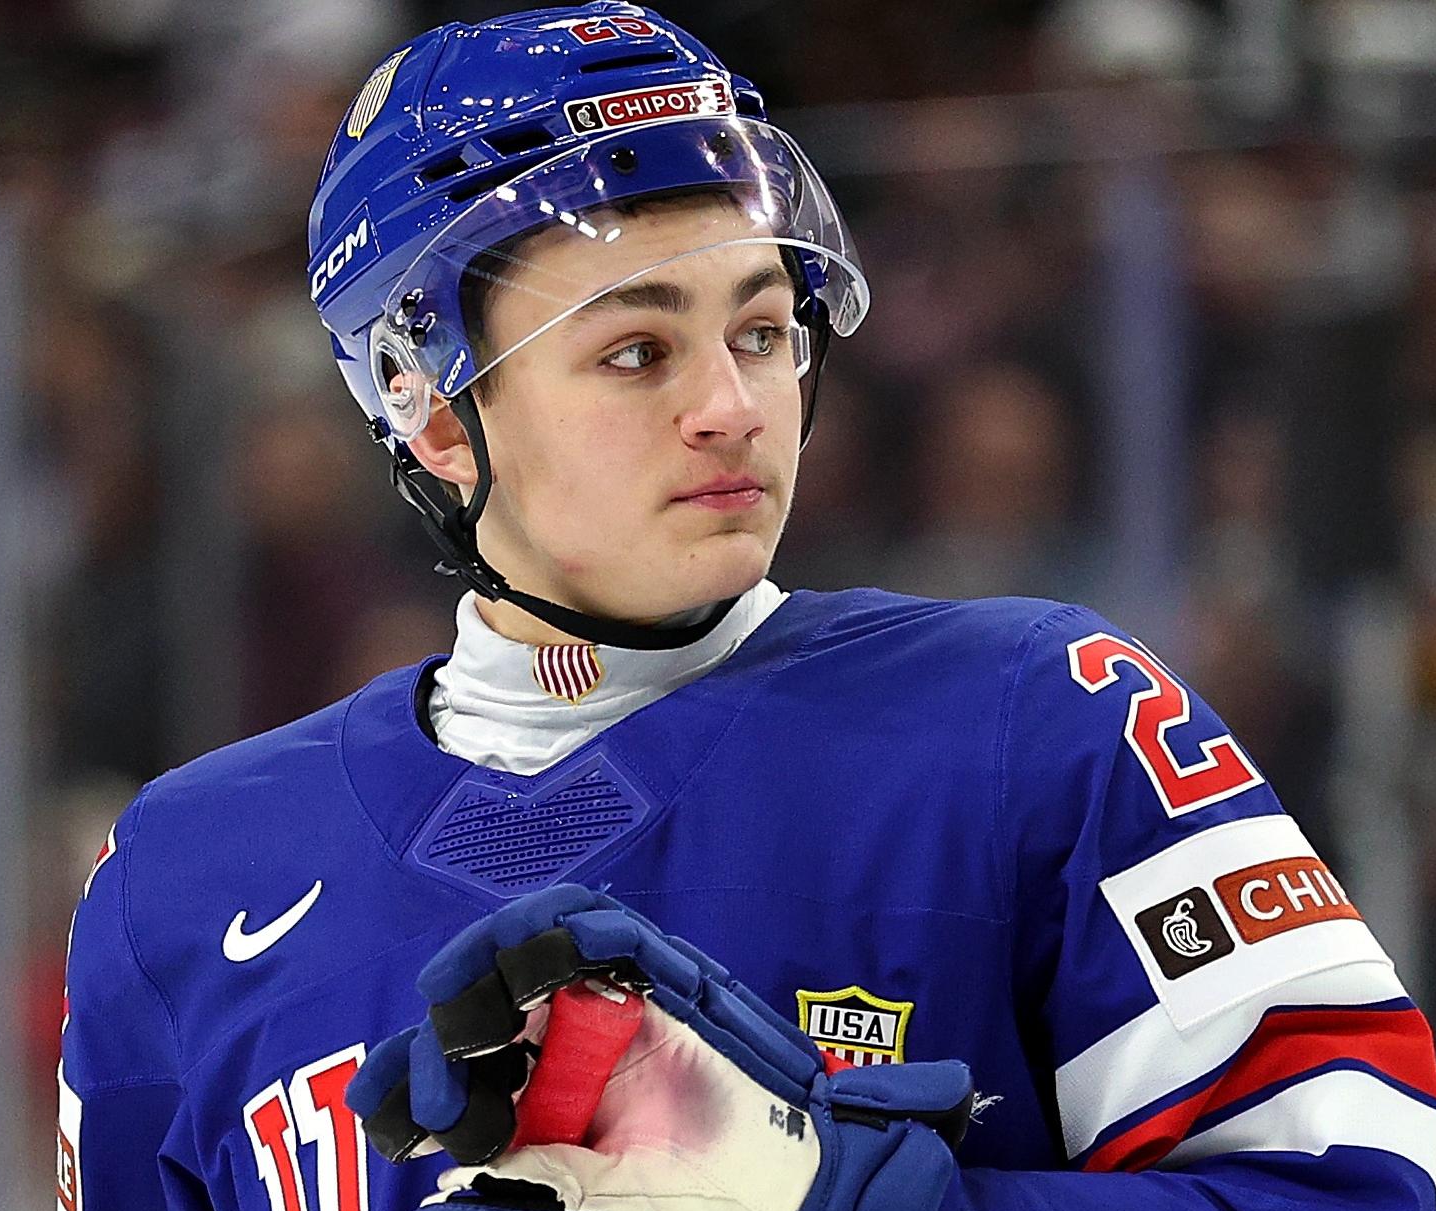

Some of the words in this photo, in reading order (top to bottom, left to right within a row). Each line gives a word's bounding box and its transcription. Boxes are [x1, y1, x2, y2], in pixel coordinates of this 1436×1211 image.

[568, 15, 658, 46] 25
[606, 87, 725, 120] CHIPOTE
[311, 217, 368, 301] CCM
[443, 349, 467, 393] CCM
[1066, 632, 1267, 820] 2
[818, 1008, 884, 1043] USA
